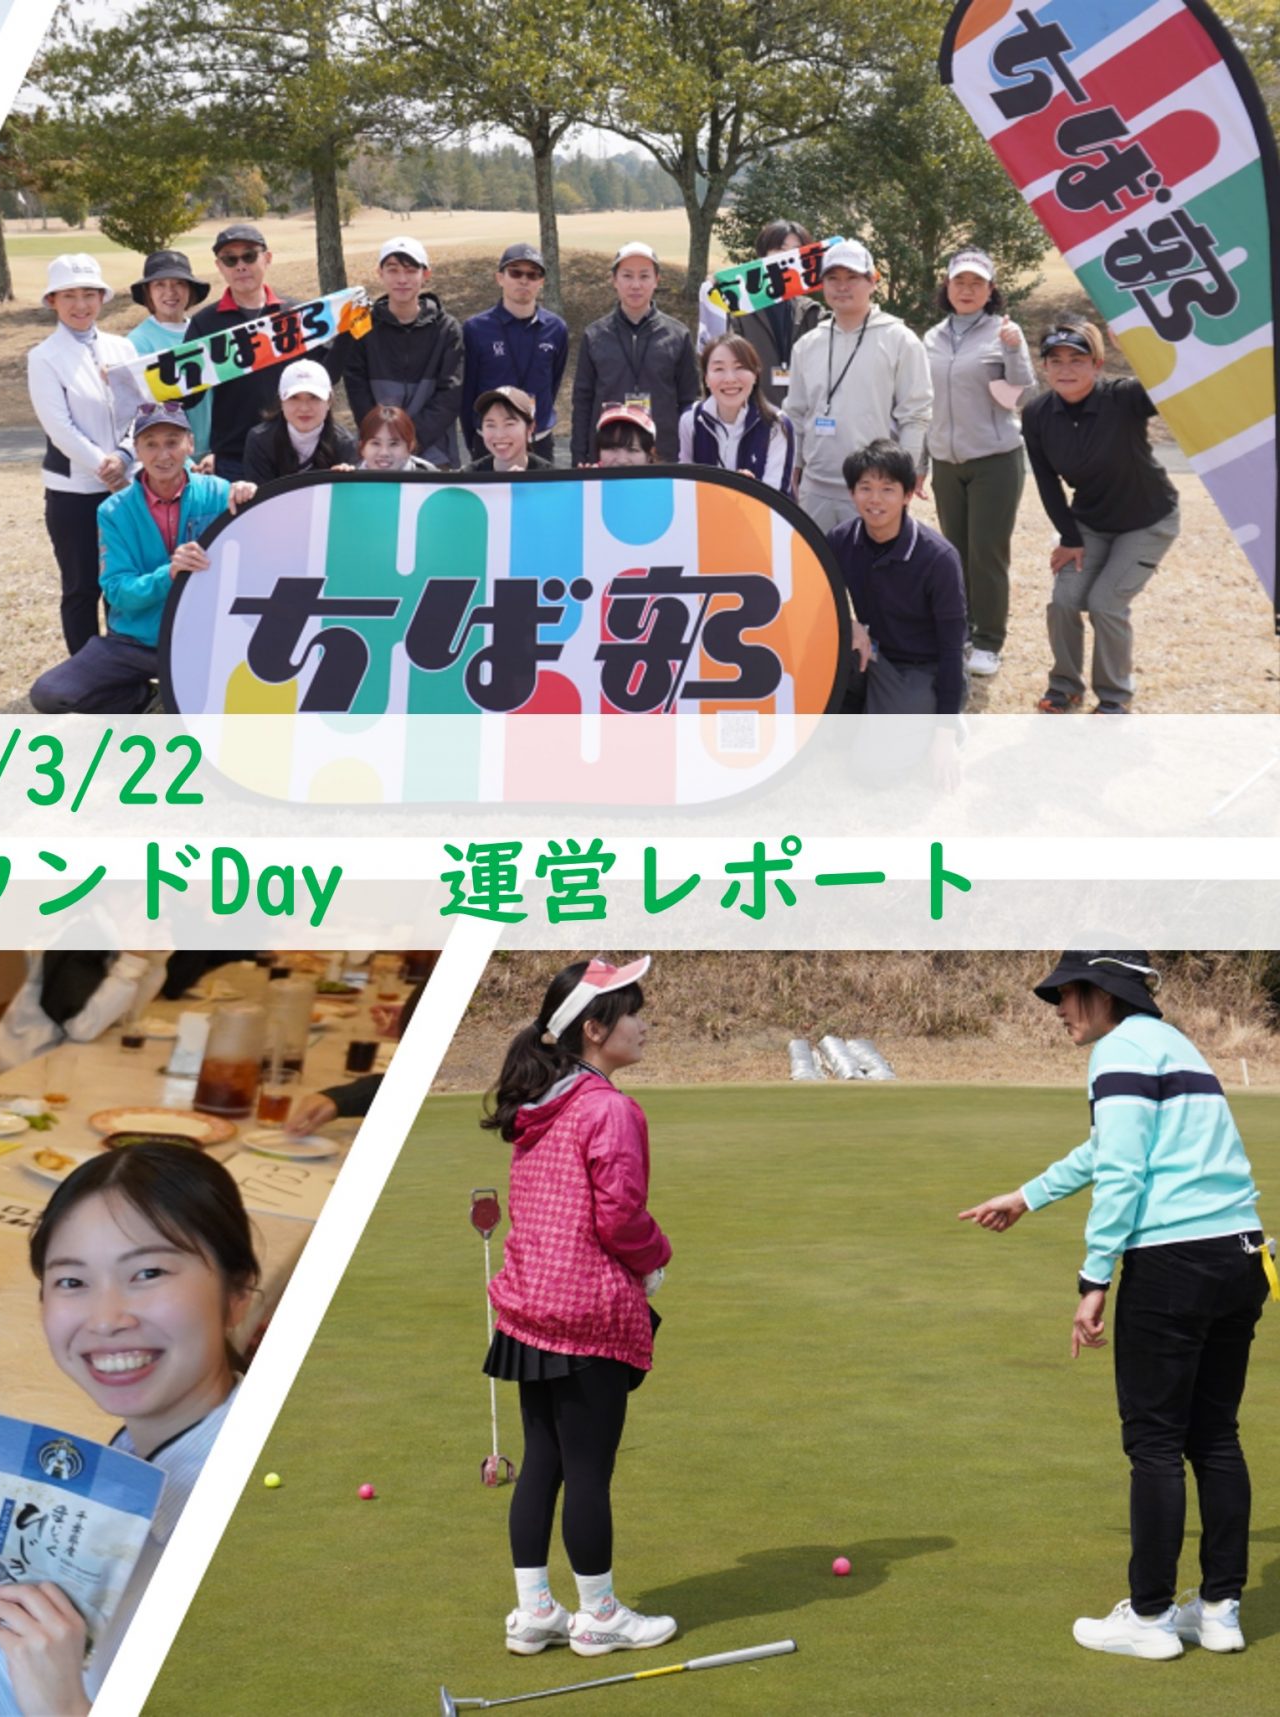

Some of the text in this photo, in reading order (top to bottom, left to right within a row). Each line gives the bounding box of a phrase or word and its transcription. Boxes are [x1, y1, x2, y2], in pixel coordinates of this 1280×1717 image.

[989, 8, 1238, 342] ちば部
[146, 301, 330, 390] ちば部
[228, 566, 783, 713] ちば部
